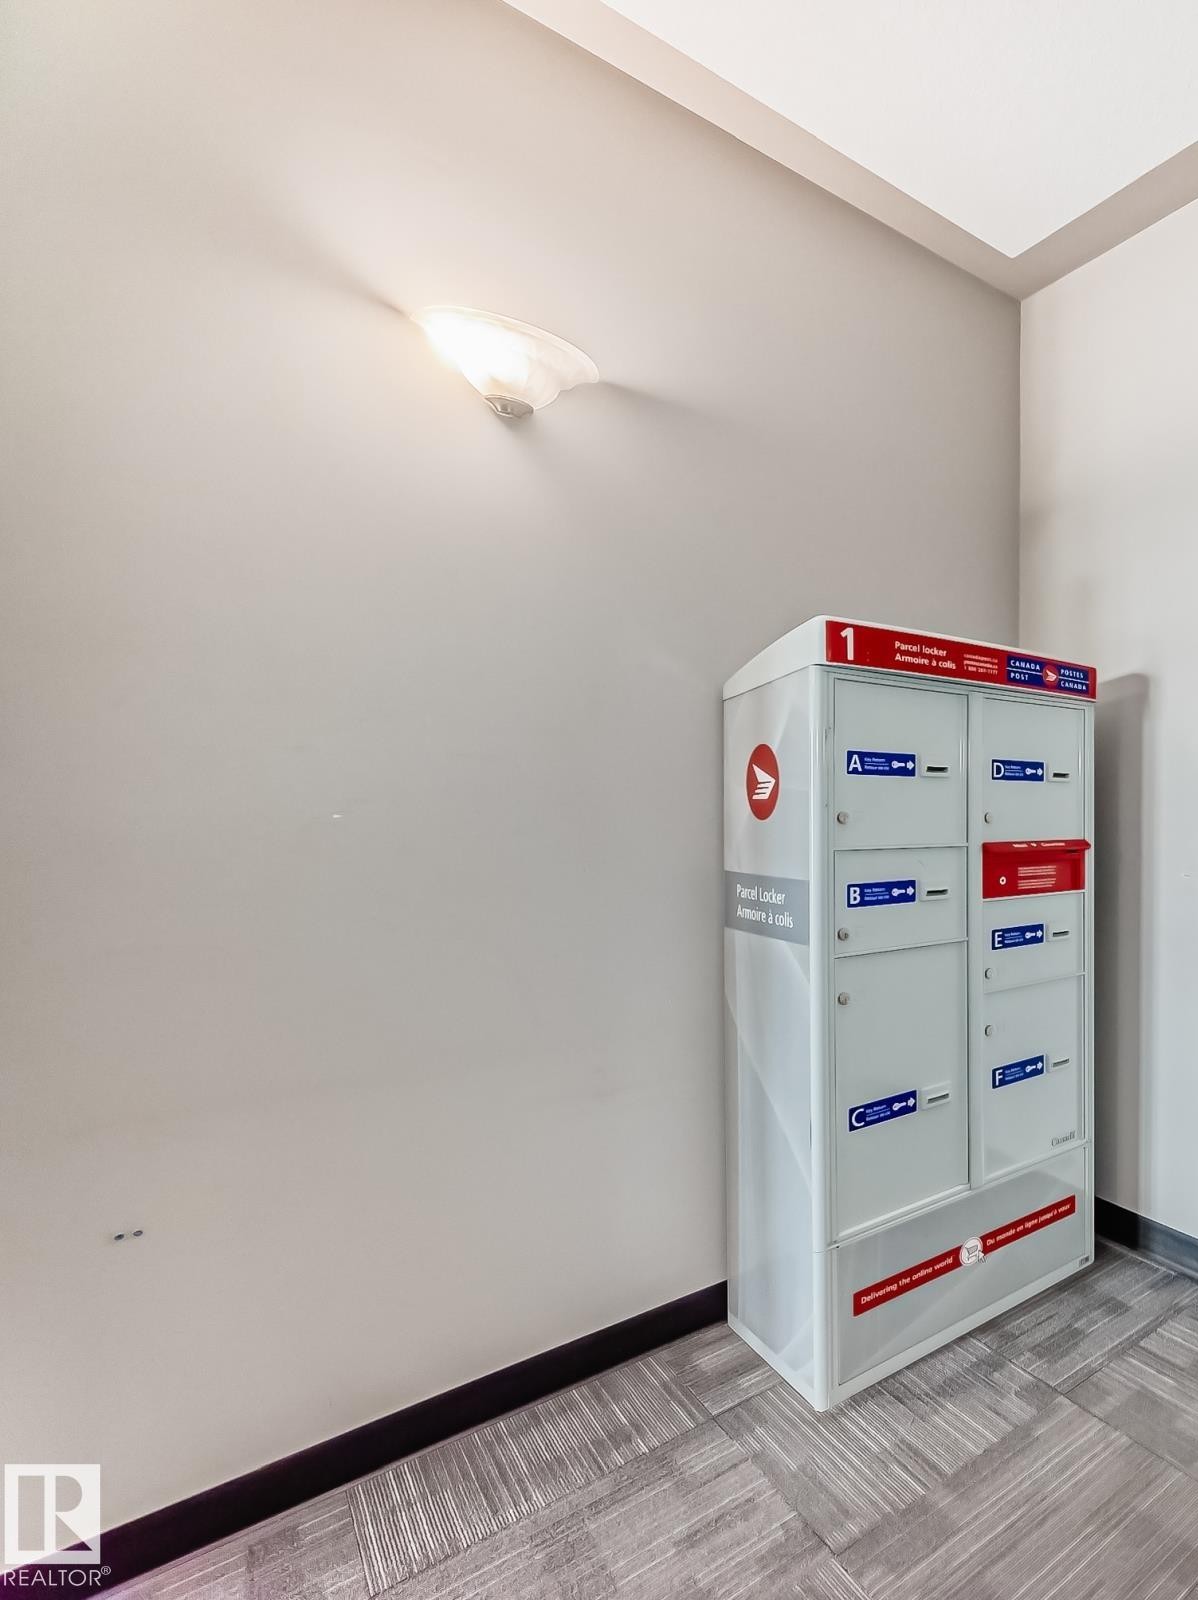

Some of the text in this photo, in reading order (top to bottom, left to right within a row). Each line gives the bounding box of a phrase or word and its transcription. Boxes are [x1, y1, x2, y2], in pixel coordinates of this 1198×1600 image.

[840, 627, 855, 661] 1
[894, 640, 948, 657] Parcel locker
[894, 653, 957, 670] Armoire à colis
[1010, 660, 1041, 671] CANADA
[1010, 672, 1029, 681] POST
[1060, 668, 1085, 679] POSTES
[1060, 681, 1087, 691] CANADA
[848, 754, 863, 772] A
[993, 762, 1005, 778] D
[736, 883, 786, 905] Parcel Locker
[849, 887, 861, 905] B
[736, 904, 794, 929] Armoire à colis
[994, 931, 1003, 948] E
[995, 1069, 1004, 1086] F
[851, 1108, 865, 1127] C
[986, 1238, 996, 1247] Du
[996, 1229, 1016, 1241] monde
[1024, 1218, 1039, 1229] ligne
[860, 1283, 898, 1305] Delivering
[899, 1278, 911, 1287] the
[912, 1267, 933, 1281] online
